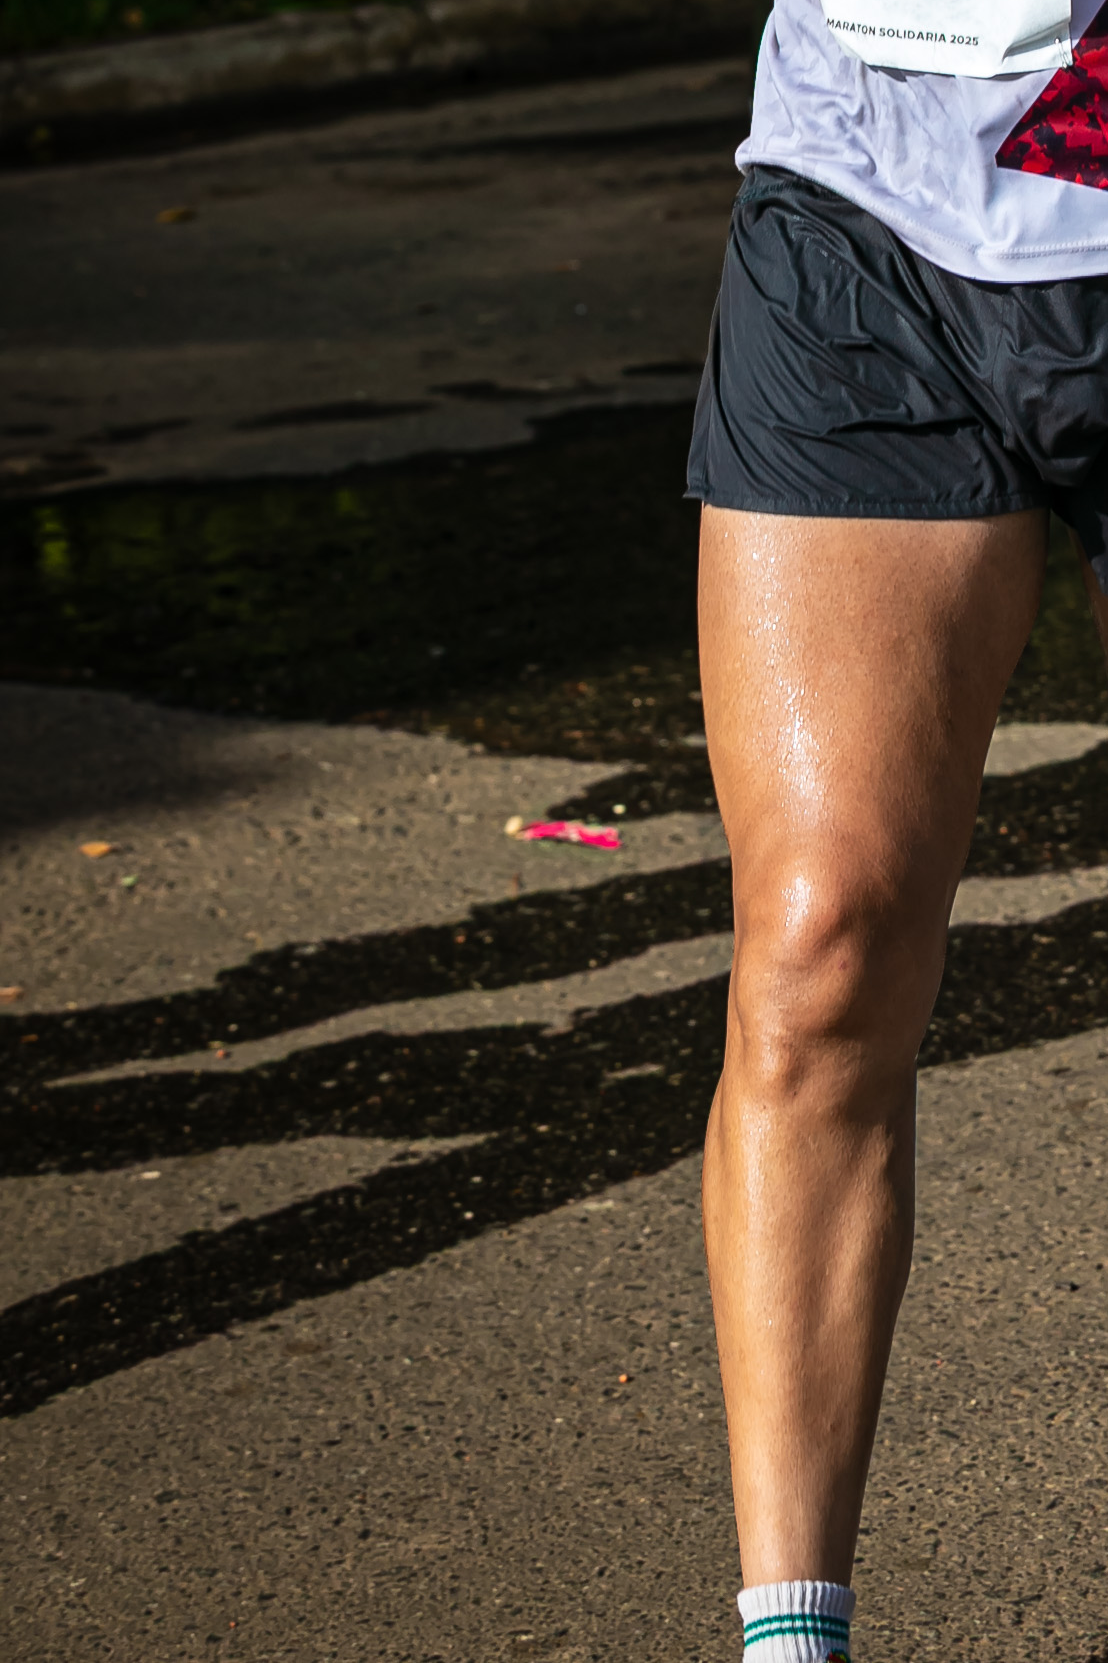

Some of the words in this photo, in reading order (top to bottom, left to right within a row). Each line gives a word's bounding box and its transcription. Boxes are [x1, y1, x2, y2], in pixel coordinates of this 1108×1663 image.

[826, 17, 876, 36] MARATON
[879, 27, 947, 43] SOLIDARIA
[950, 34, 979, 46] 2025
